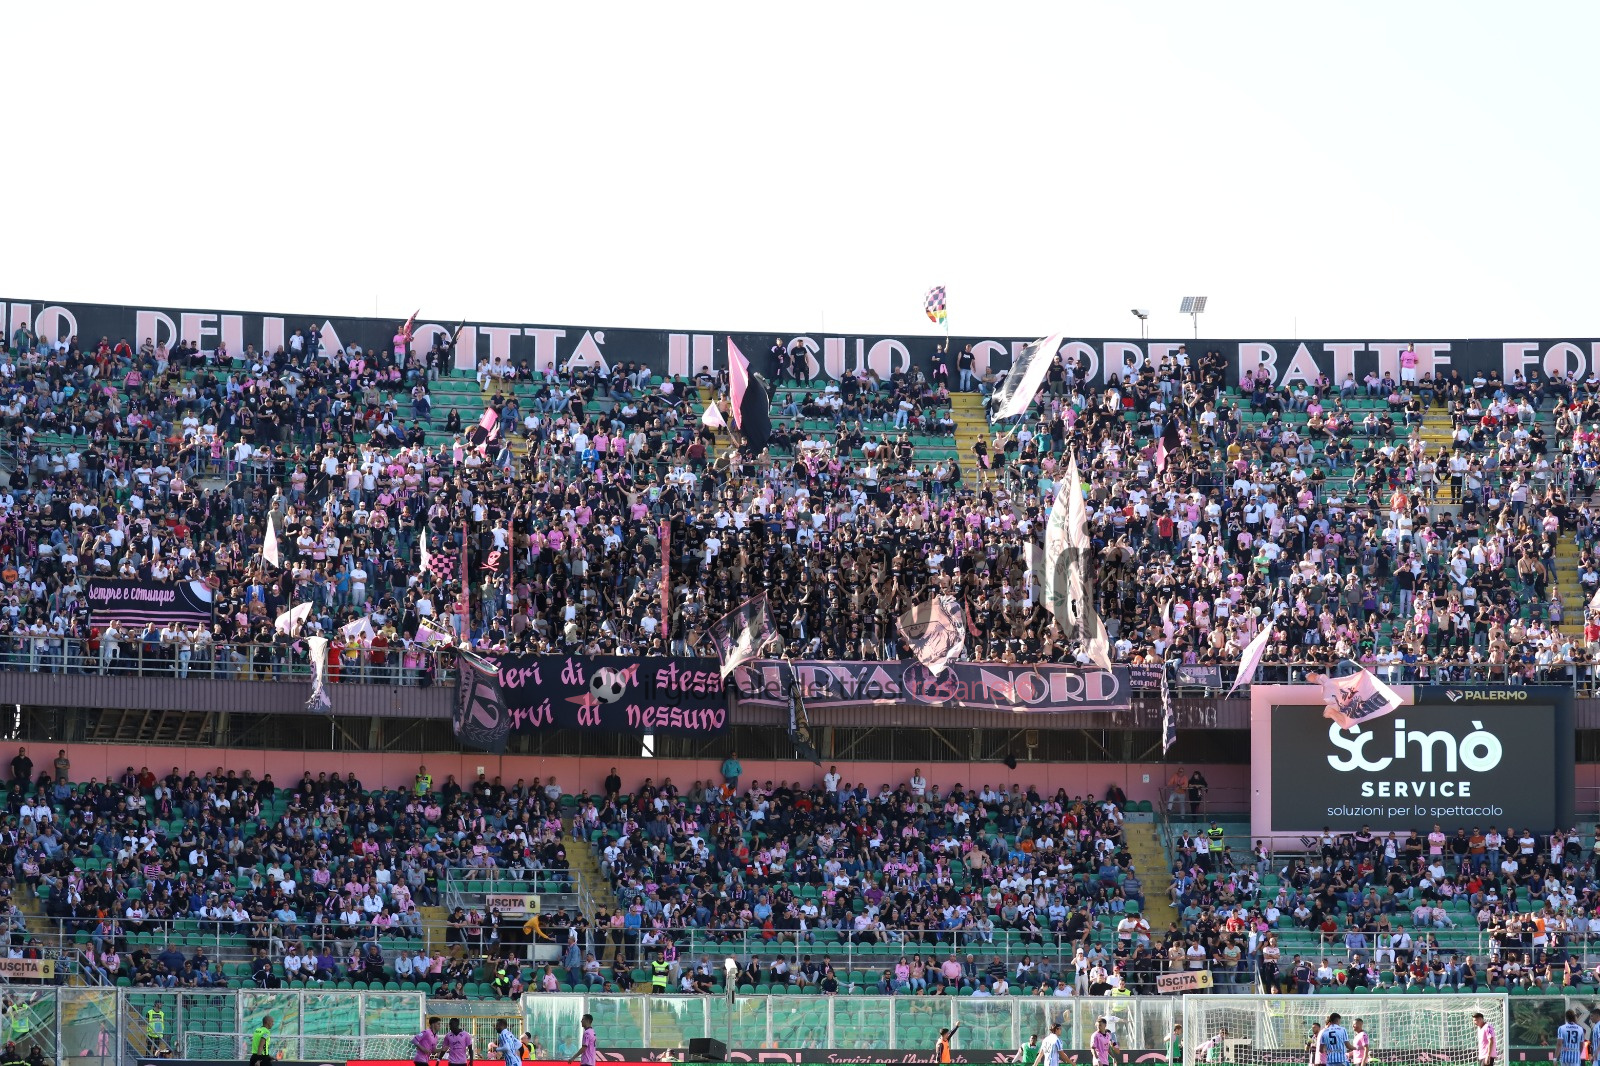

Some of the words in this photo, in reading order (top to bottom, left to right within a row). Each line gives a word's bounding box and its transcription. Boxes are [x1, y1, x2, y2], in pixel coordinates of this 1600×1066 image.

[970, 340, 1186, 384] CORE
[1238, 342, 1451, 387] BATTE
[1503, 342, 1600, 385] FO
[89, 584, 122, 604] sempre
[123, 588, 129, 599] e
[561, 657, 585, 686] di
[980, 668, 1119, 704] NORD
[1465, 690, 1527, 701] PALERMO
[577, 692, 601, 727] di
[625, 703, 726, 730] nessuno
[1361, 781, 1471, 798] SERVICE
[1327, 804, 1384, 817] soluzioni
[1388, 807, 1410, 819] per
[1414, 804, 1426, 817] lo
[1431, 804, 1503, 819] spettacolo
[487, 898, 525, 908] USCITA
[530, 900, 536, 909] 8
[0, 962, 38, 972] USCITA
[43, 964, 50, 974] 6
[1158, 975, 1197, 987] USCITA
[1201, 975, 1208, 984] 9
[1329, 1031, 1337, 1045] 5
[1566, 1030, 1578, 1044] 13
